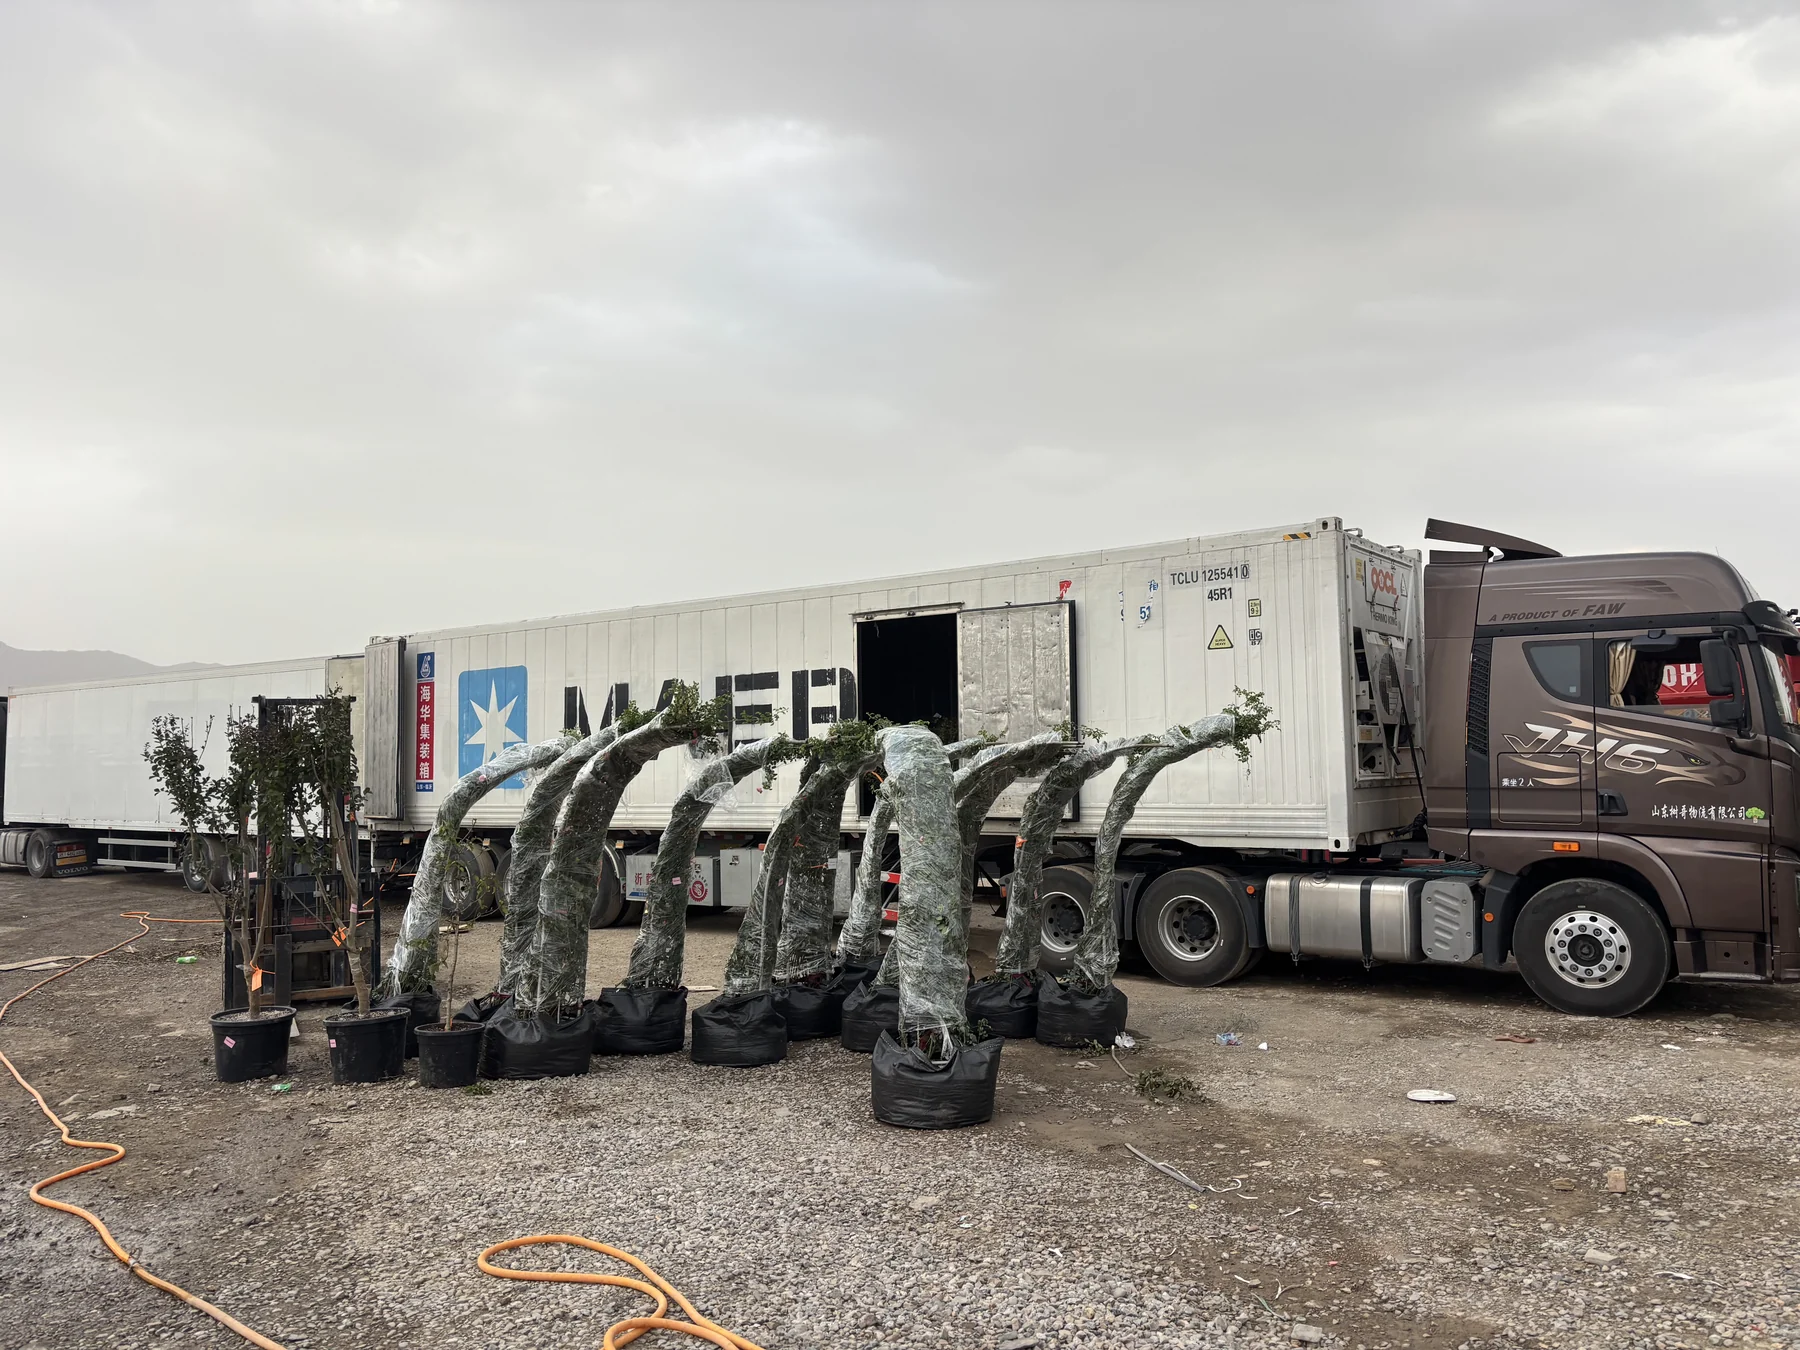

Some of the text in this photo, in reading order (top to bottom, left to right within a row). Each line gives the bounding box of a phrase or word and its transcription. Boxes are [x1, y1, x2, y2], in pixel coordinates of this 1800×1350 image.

[1170, 570, 1199, 585] TCLU
[1371, 567, 1397, 595] OOCL
[1207, 587, 1233, 601] 45R1
[1489, 602, 1626, 622] A PRODUCT OF FAW
[419, 685, 431, 779] 海华集装箱
[1502, 722, 1671, 775] JH6
[1651, 804, 1746, 820] 山东树哥物流有限公司
[58, 866, 88, 875] VOLVO
